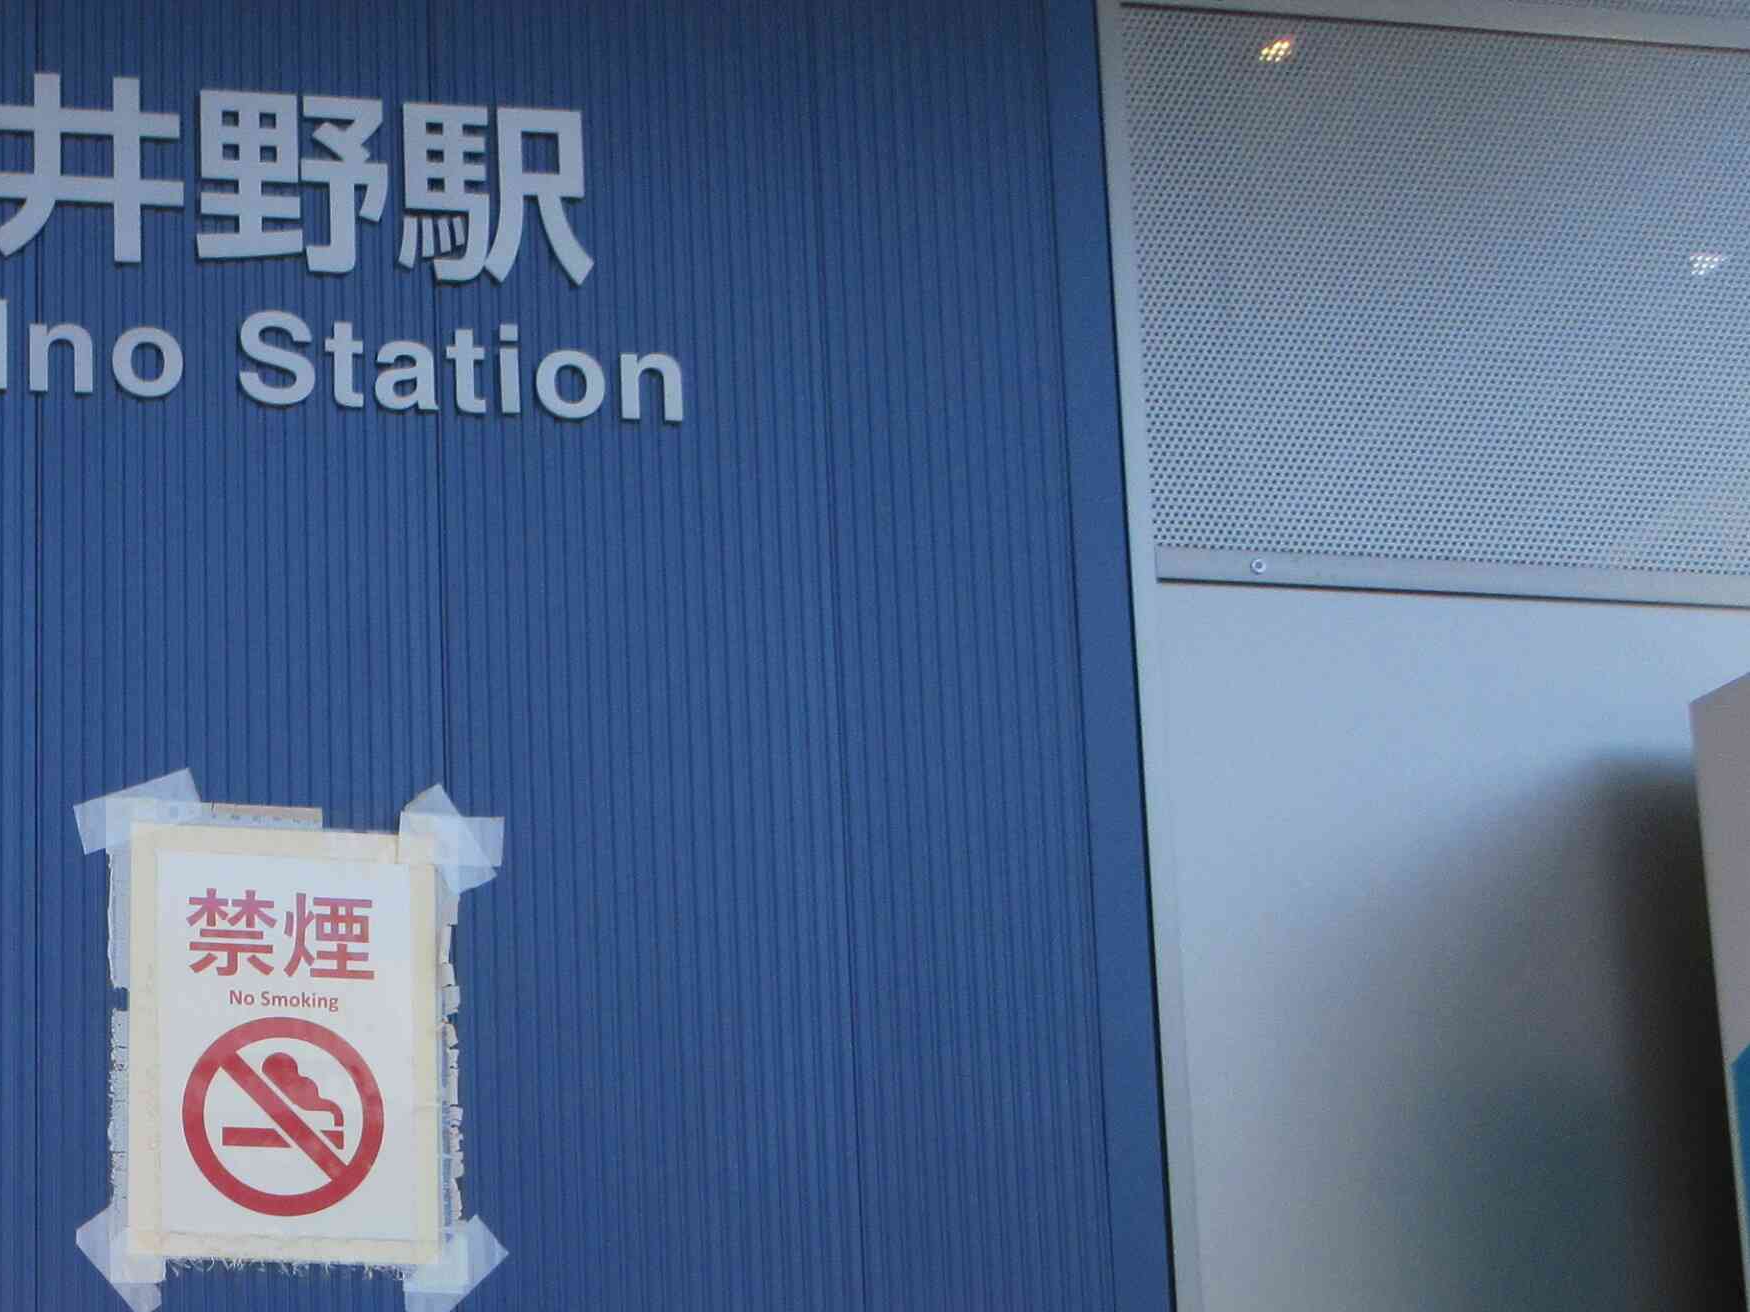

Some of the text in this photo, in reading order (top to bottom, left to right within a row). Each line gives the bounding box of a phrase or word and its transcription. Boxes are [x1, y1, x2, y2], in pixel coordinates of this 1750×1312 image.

[239, 309, 684, 422] Station
[184, 886, 376, 981] 禁煙
[229, 989, 340, 1012] No Smoking
